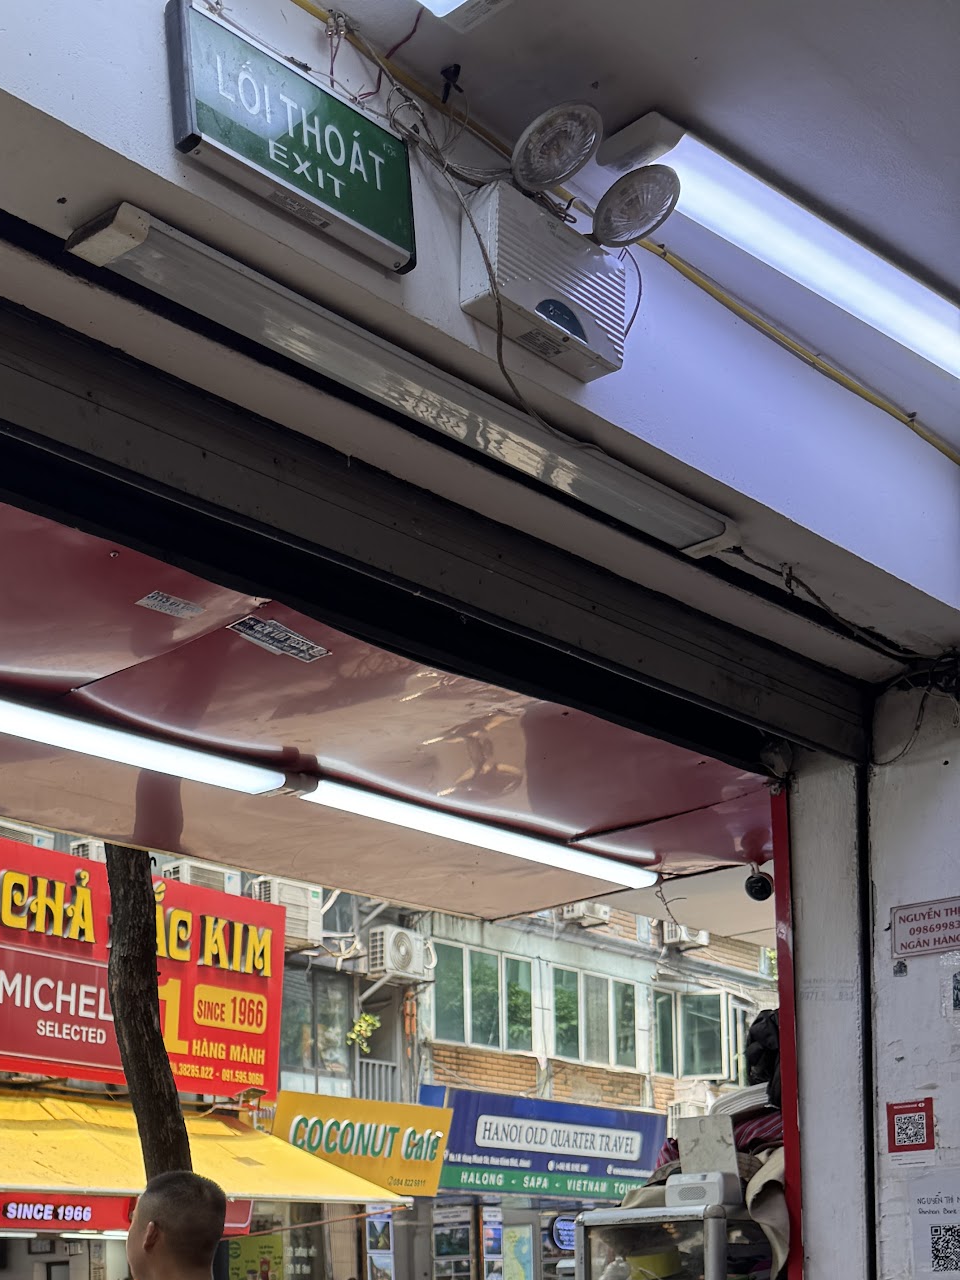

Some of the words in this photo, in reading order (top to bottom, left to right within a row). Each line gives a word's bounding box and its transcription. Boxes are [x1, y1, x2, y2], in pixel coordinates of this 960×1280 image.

[215, 54, 274, 124] LỐI
[279, 92, 386, 191] THOÁT
[268, 140, 346, 199] EXIT
[198, 914, 272, 977] KIM
[196, 999, 226, 1022] SINCE
[231, 996, 264, 1029] 1966
[36, 1019, 107, 1045] SELECTED
[192, 1038, 226, 1060] HÀNG
[229, 1044, 266, 1066] MÀNH
[289, 1114, 400, 1158] COCONUT
[482, 1121, 522, 1144] HANOI
[525, 1126, 548, 1146] OLD
[550, 1130, 596, 1151] QUARTER
[599, 1134, 635, 1155] TRAVEL
[460, 1171, 504, 1186] HALONG
[522, 1175, 549, 1189] SAPA
[566, 1179, 607, 1193] VIETNAM
[6, 1202, 54, 1221] SINCE
[57, 1204, 92, 1222] 1966
